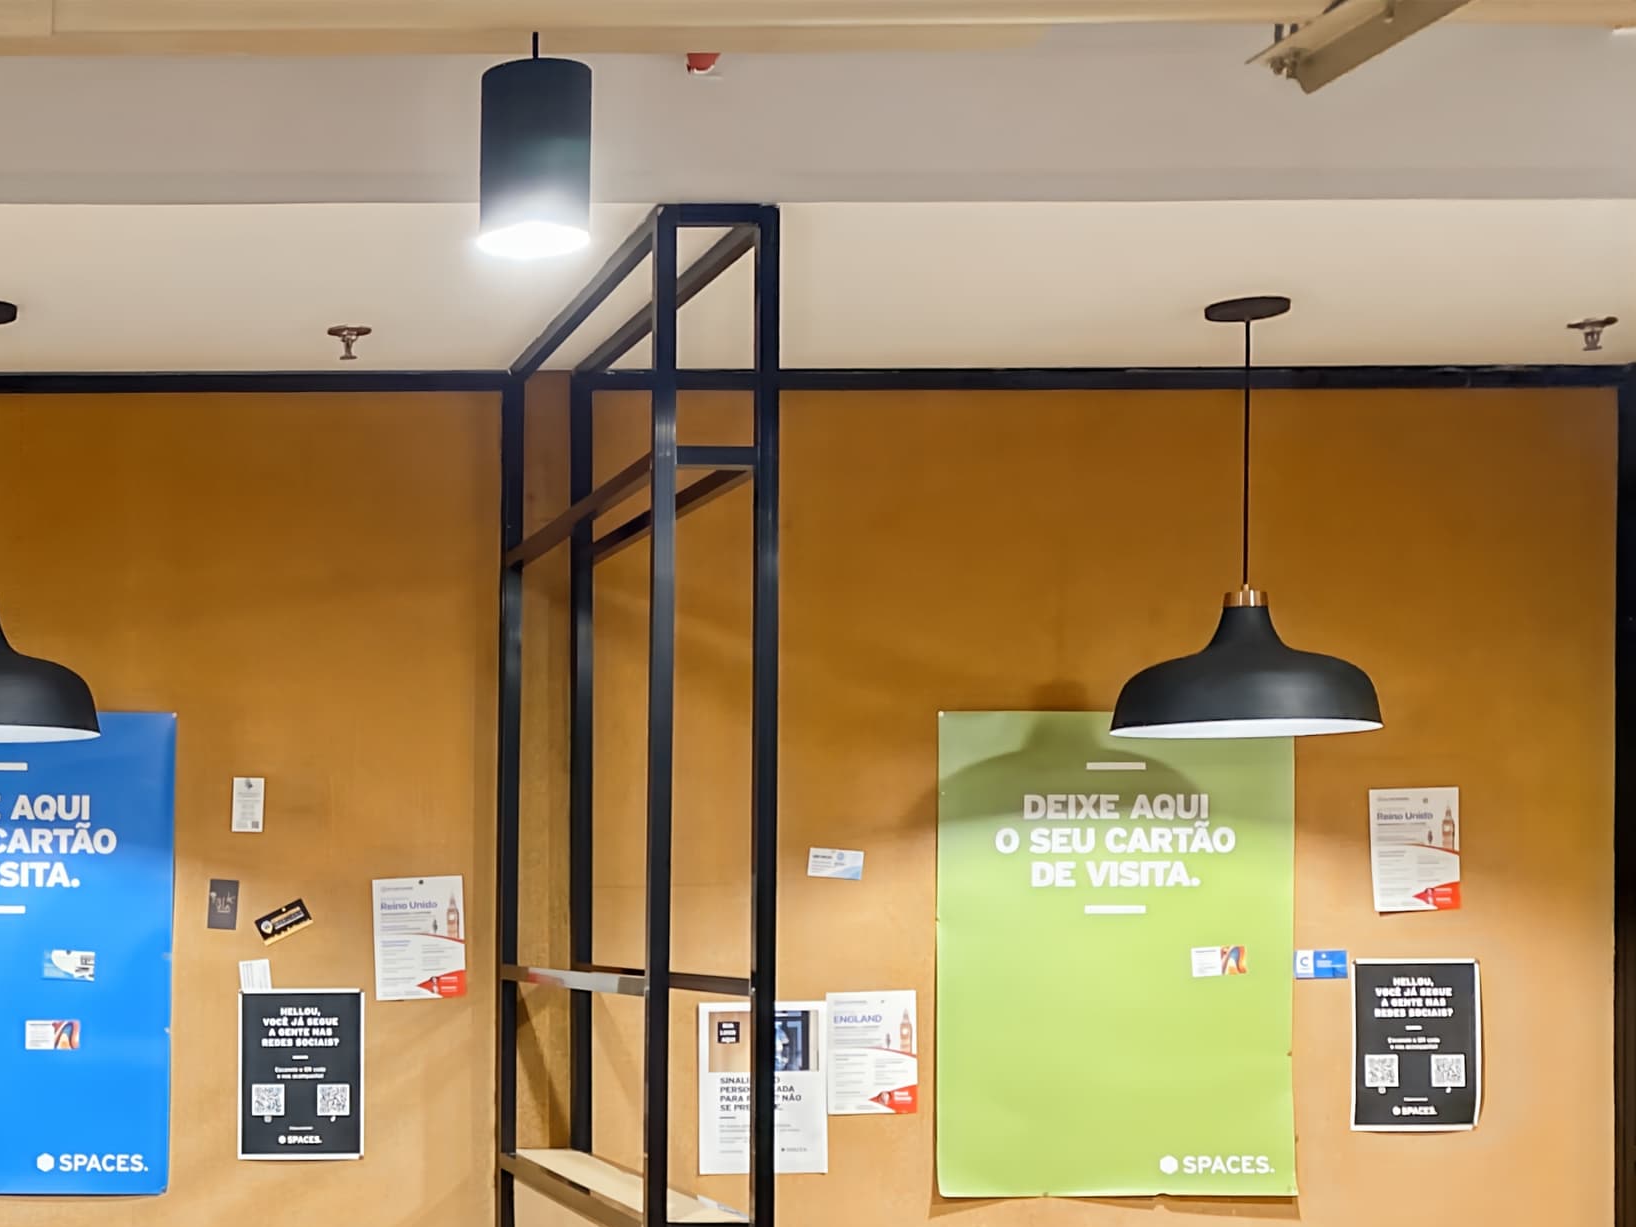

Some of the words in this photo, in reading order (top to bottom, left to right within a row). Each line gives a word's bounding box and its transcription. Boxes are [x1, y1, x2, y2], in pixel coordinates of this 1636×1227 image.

[10, 794, 91, 822] AQUI
[1023, 794, 1120, 820] DEIXE
[1130, 793, 1209, 820] AQUI
[995, 827, 1020, 853] O
[1029, 827, 1096, 853] SEU
[1105, 820, 1236, 854] CARTÃO
[1031, 860, 1077, 887] DE
[1086, 860, 1201, 887] VISITA.
[380, 902, 407, 910] Reino
[409, 900, 438, 910] Unido
[1381, 998, 1389, 1007] A
[263, 1016, 289, 1026] VOCÊ
[291, 1016, 304, 1026] JÁ
[307, 1017, 339, 1026] SEGUE
[833, 1014, 882, 1024] ENGLAND
[268, 1028, 276, 1037] A
[278, 1028, 310, 1037] GENTE
[312, 1028, 332, 1037] NAS
[262, 1038, 293, 1047] REDES
[295, 1038, 339, 1047] SOCIAIS?
[720, 1095, 743, 1103] PARA
[58, 1153, 149, 1172] SPACES.
[1183, 1155, 1275, 1174] SPACES.
